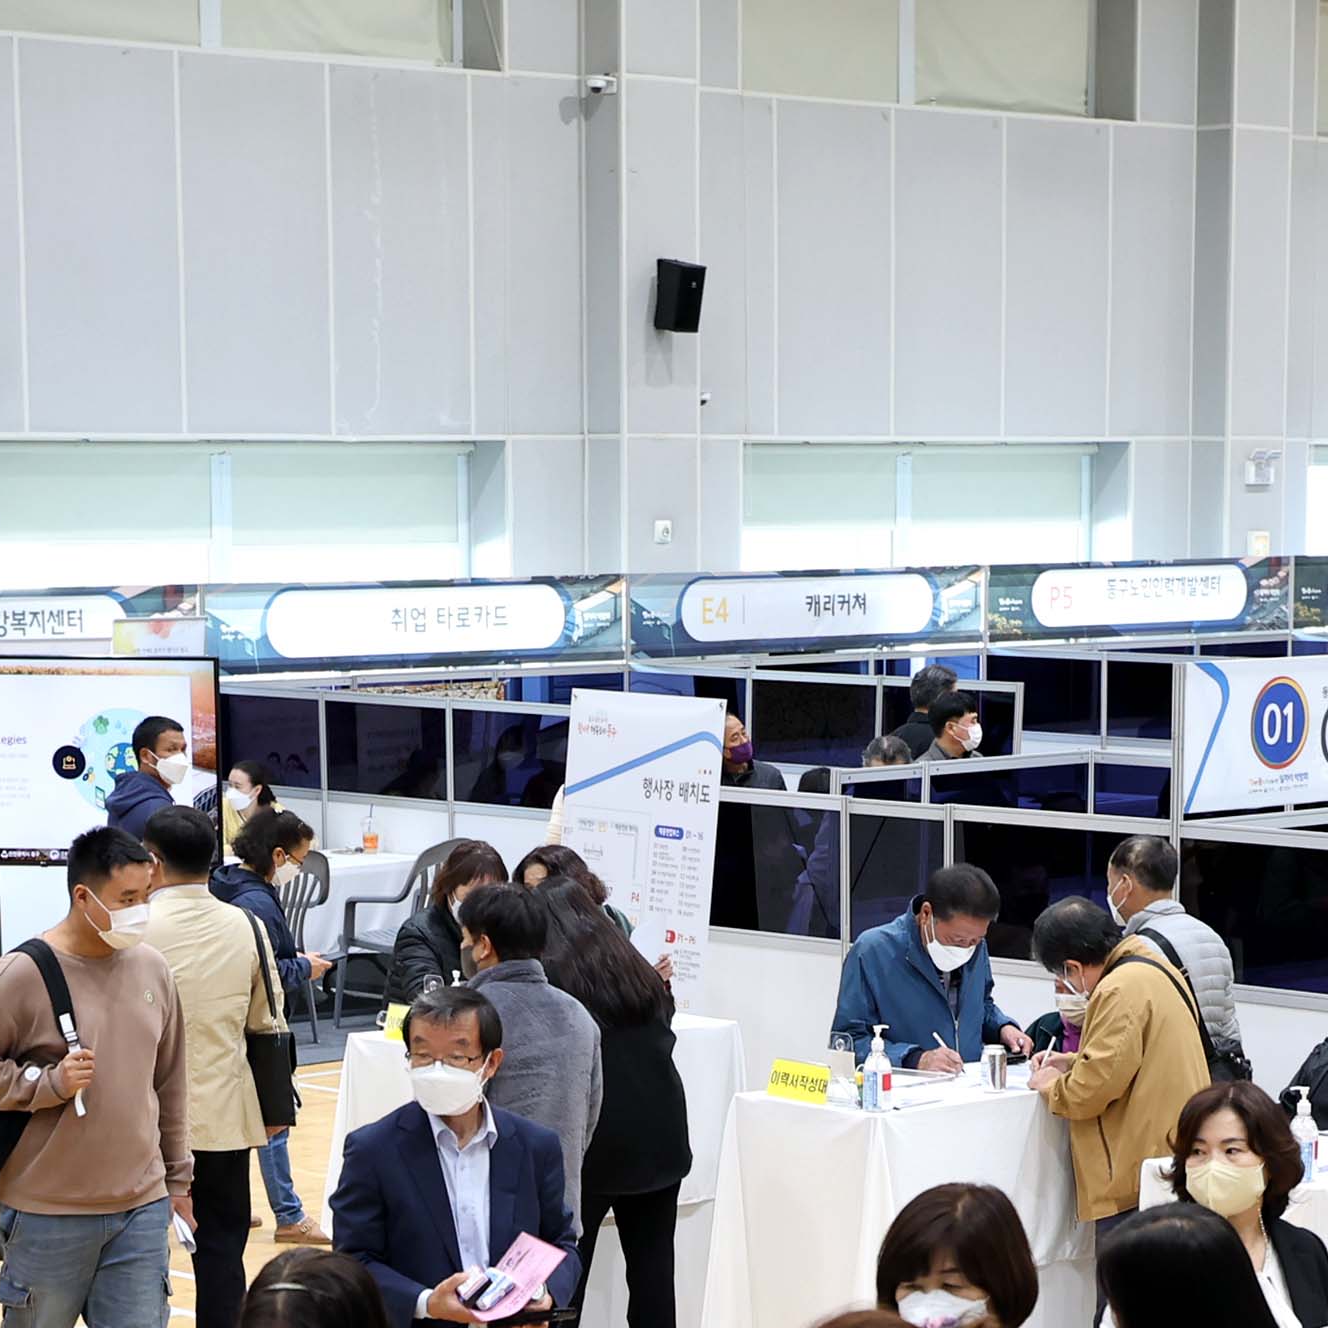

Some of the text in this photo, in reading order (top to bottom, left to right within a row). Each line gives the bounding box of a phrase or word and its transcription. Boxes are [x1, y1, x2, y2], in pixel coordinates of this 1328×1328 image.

[1050, 585, 1073, 610] P5
[1106, 575, 1221, 599] 동구노인인력개발센터
[391, 605, 509, 632] 취업 타로카드
[701, 597, 729, 625] E4
[1262, 701, 1294, 745] 01
[642, 777, 711, 804] 행사장 배치도
[771, 1070, 828, 1094] 이력서작성대
